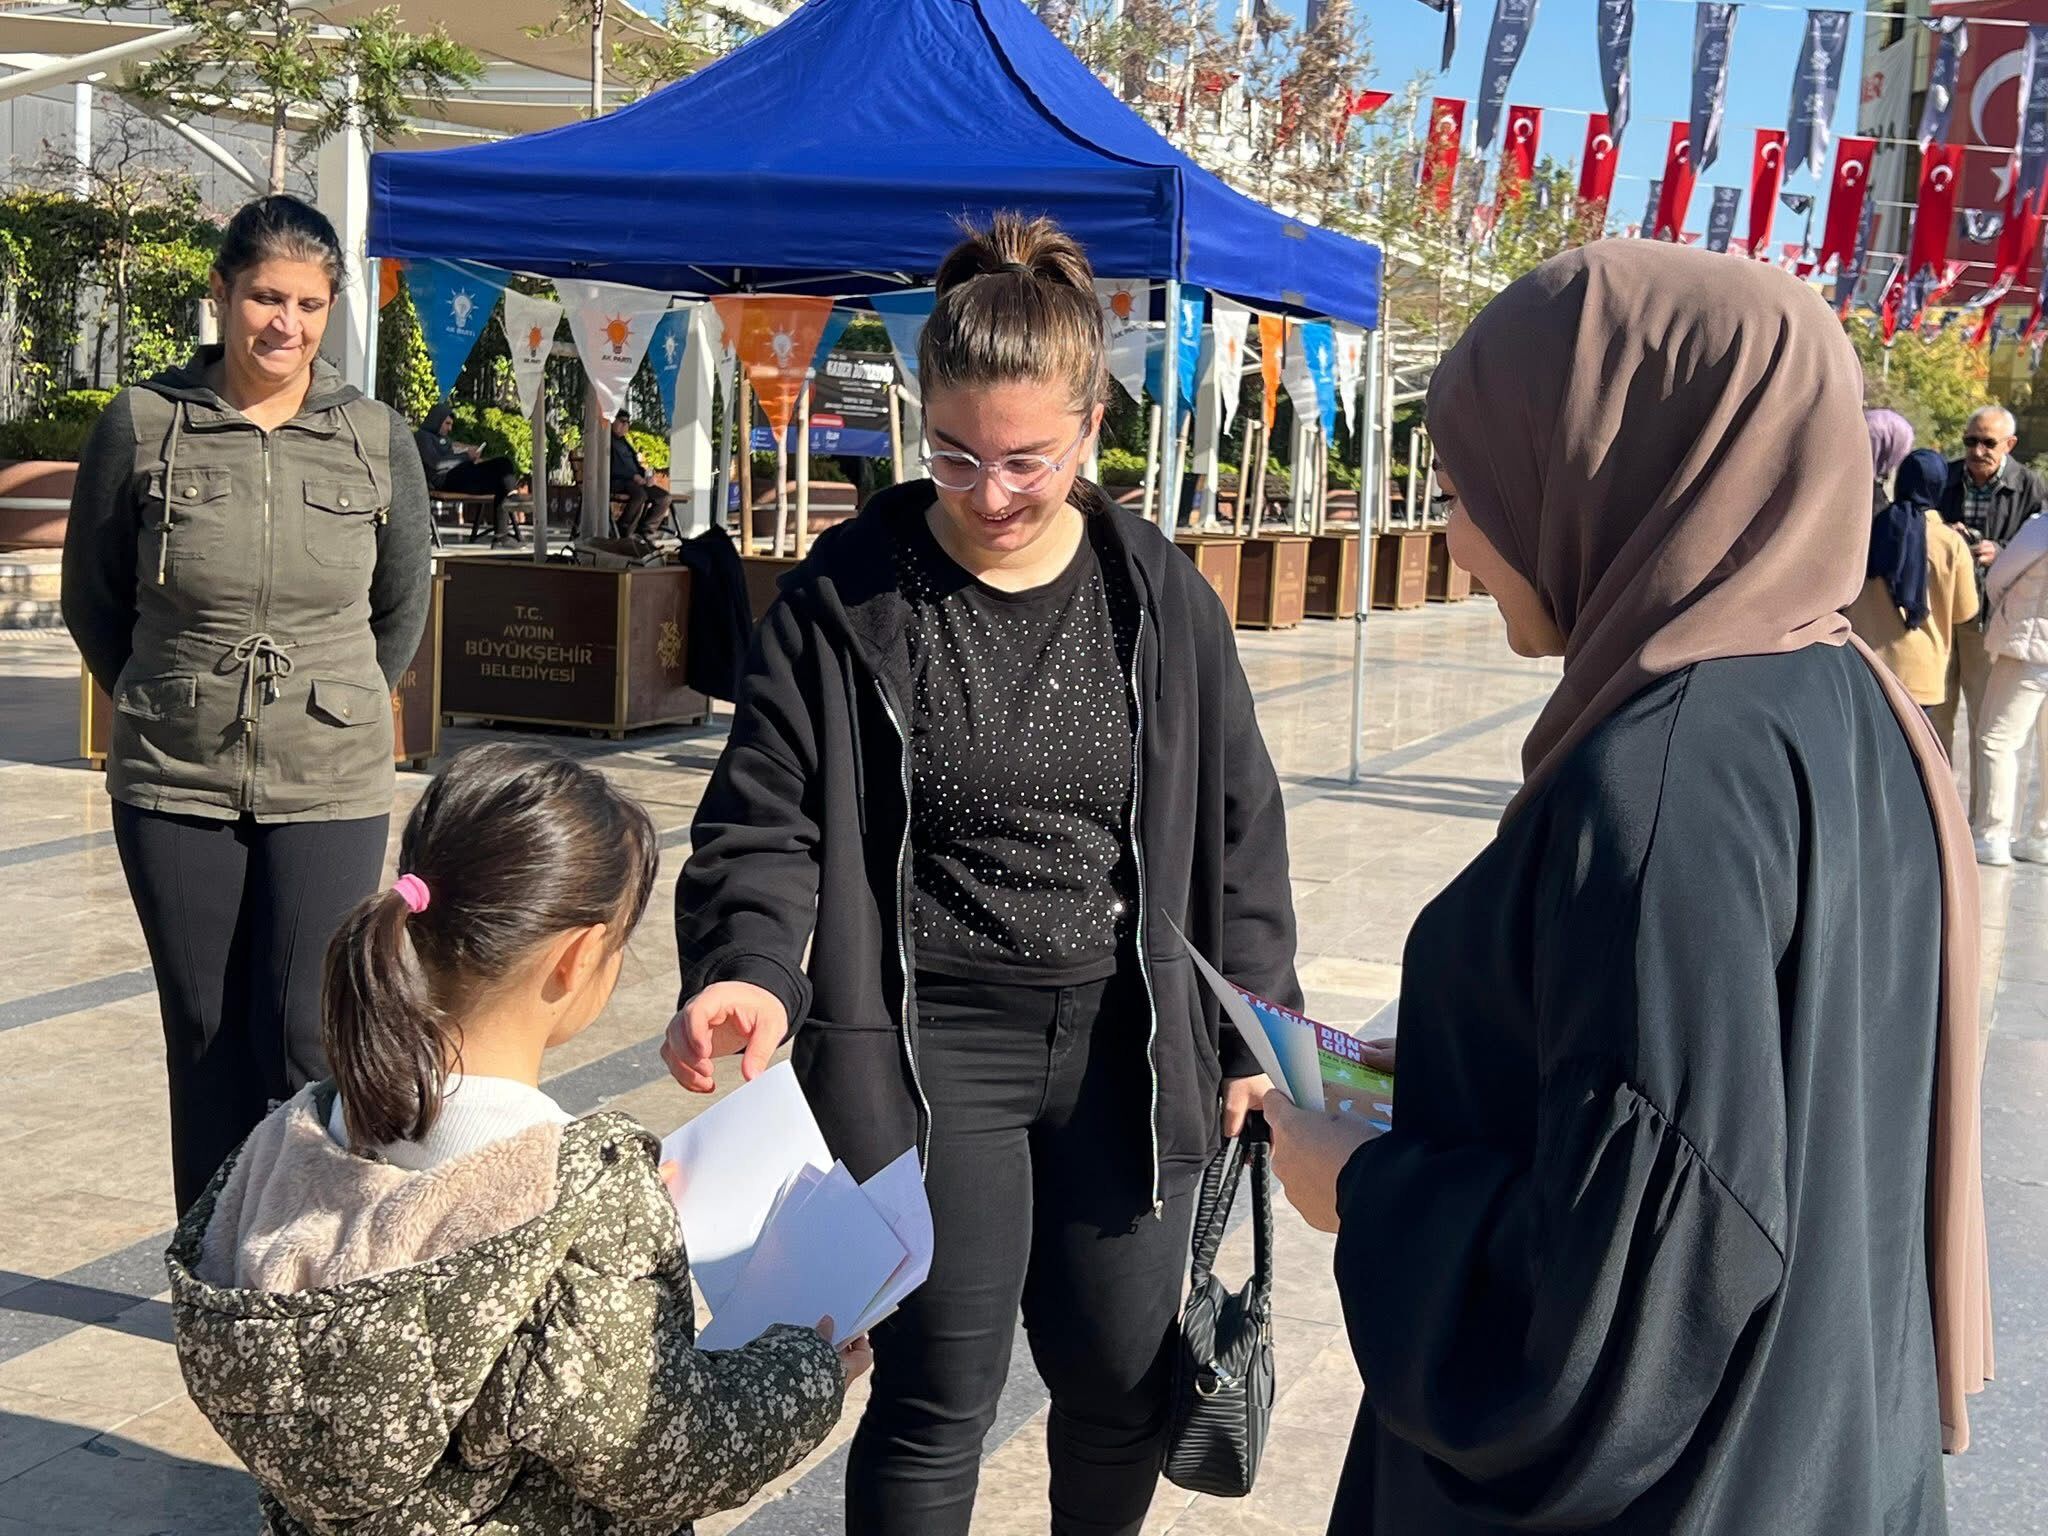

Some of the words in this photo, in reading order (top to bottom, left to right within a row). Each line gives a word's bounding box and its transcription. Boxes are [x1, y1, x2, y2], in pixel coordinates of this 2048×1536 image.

[515, 606, 543, 620] T.C.
[503, 624, 554, 640] AYDIN
[465, 638, 592, 665] BÜYÜKŞEHİR
[481, 663, 575, 682] BELEDİYESİ
